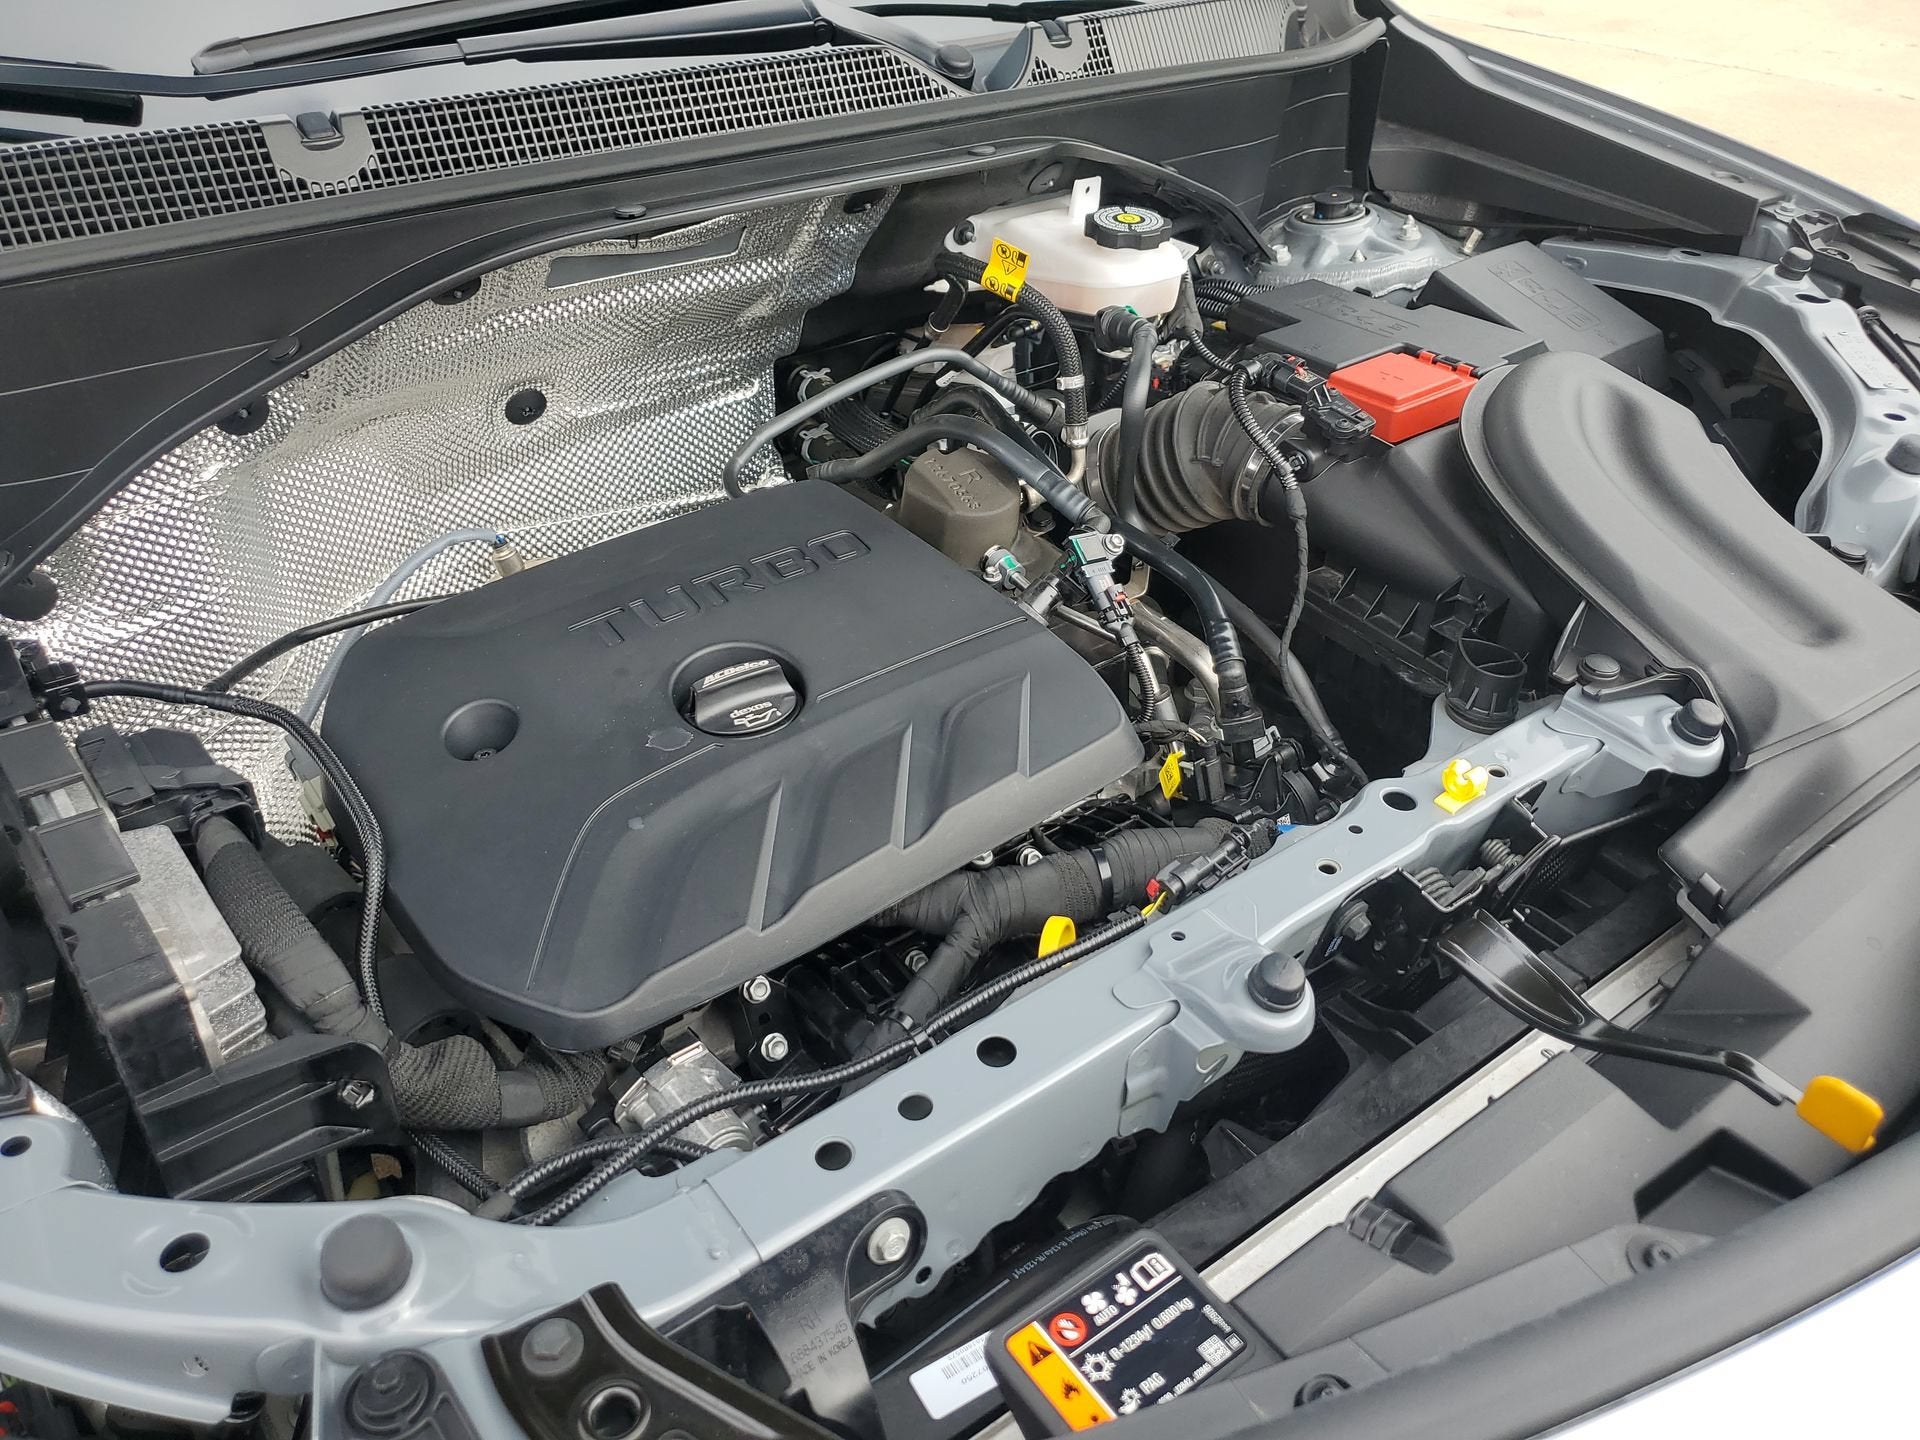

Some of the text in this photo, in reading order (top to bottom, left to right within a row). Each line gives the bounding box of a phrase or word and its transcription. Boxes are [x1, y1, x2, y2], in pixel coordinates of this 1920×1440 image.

[567, 528, 872, 648] TURBO
[702, 659, 770, 689] ACDelco
[729, 701, 773, 719] dexos
[801, 1310, 822, 1334] RH
[1093, 1304, 1119, 1327] AUTO
[1109, 1324, 1155, 1360] R-1234yf
[1175, 1297, 1195, 1312] kg
[817, 1353, 828, 1367] IN
[829, 1335, 854, 1356] KOREA
[1139, 1371, 1166, 1395] PAG
